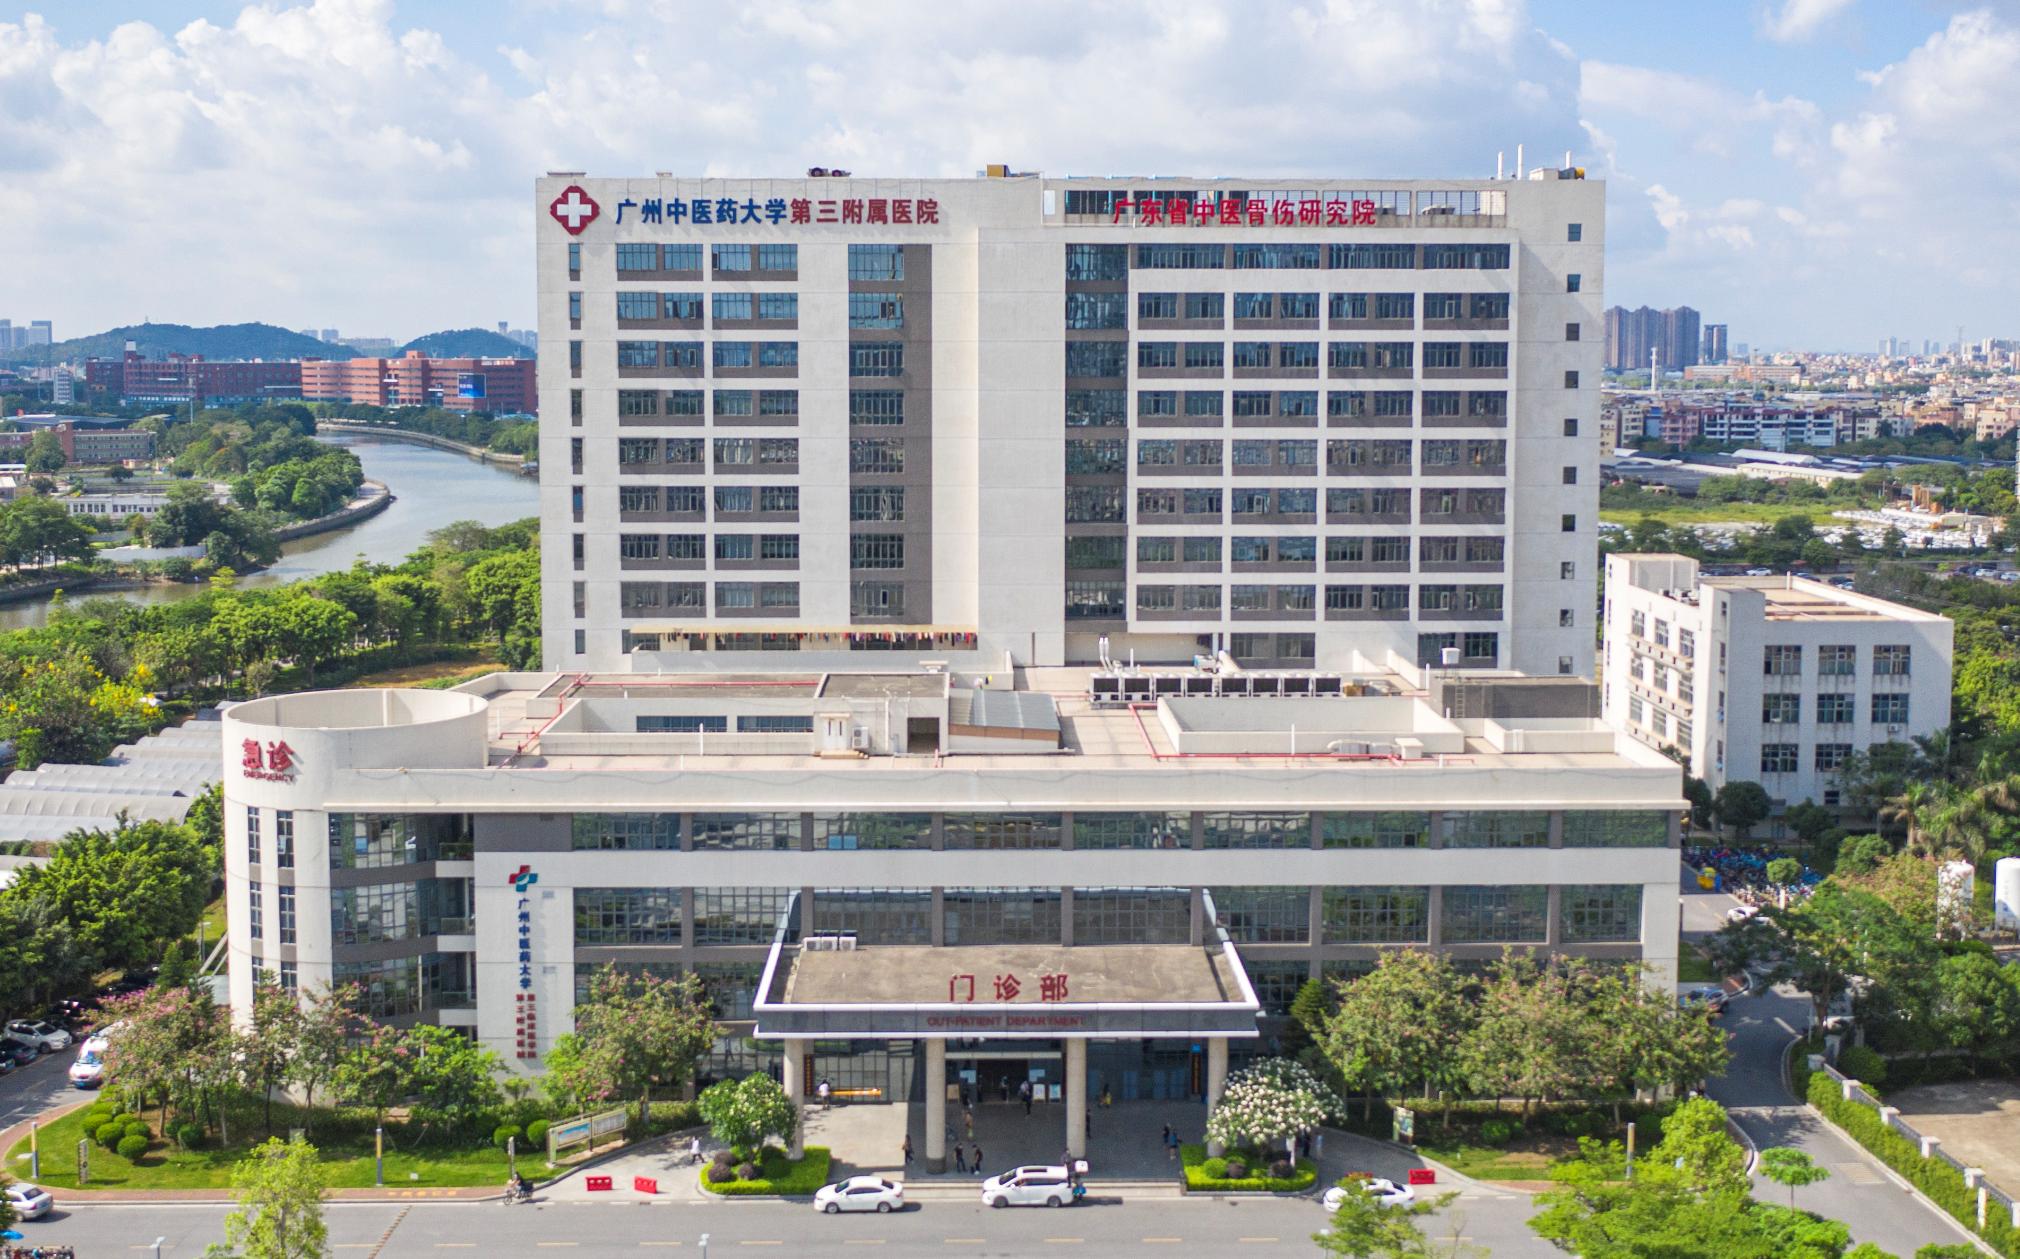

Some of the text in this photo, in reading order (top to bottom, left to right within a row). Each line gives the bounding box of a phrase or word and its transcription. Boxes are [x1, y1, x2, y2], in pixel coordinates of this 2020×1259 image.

[615, 198, 940, 225] 广州中医药大学第三附属医院
[1113, 197, 1376, 225] 广东省中医骨伤研究院
[242, 737, 294, 772] 急诊
[518, 897, 532, 989] 广州中医药大学
[949, 974, 1069, 1001] 门诊部
[927, 1015, 1085, 1027] OUT-PATIENT DEPARTMENT
